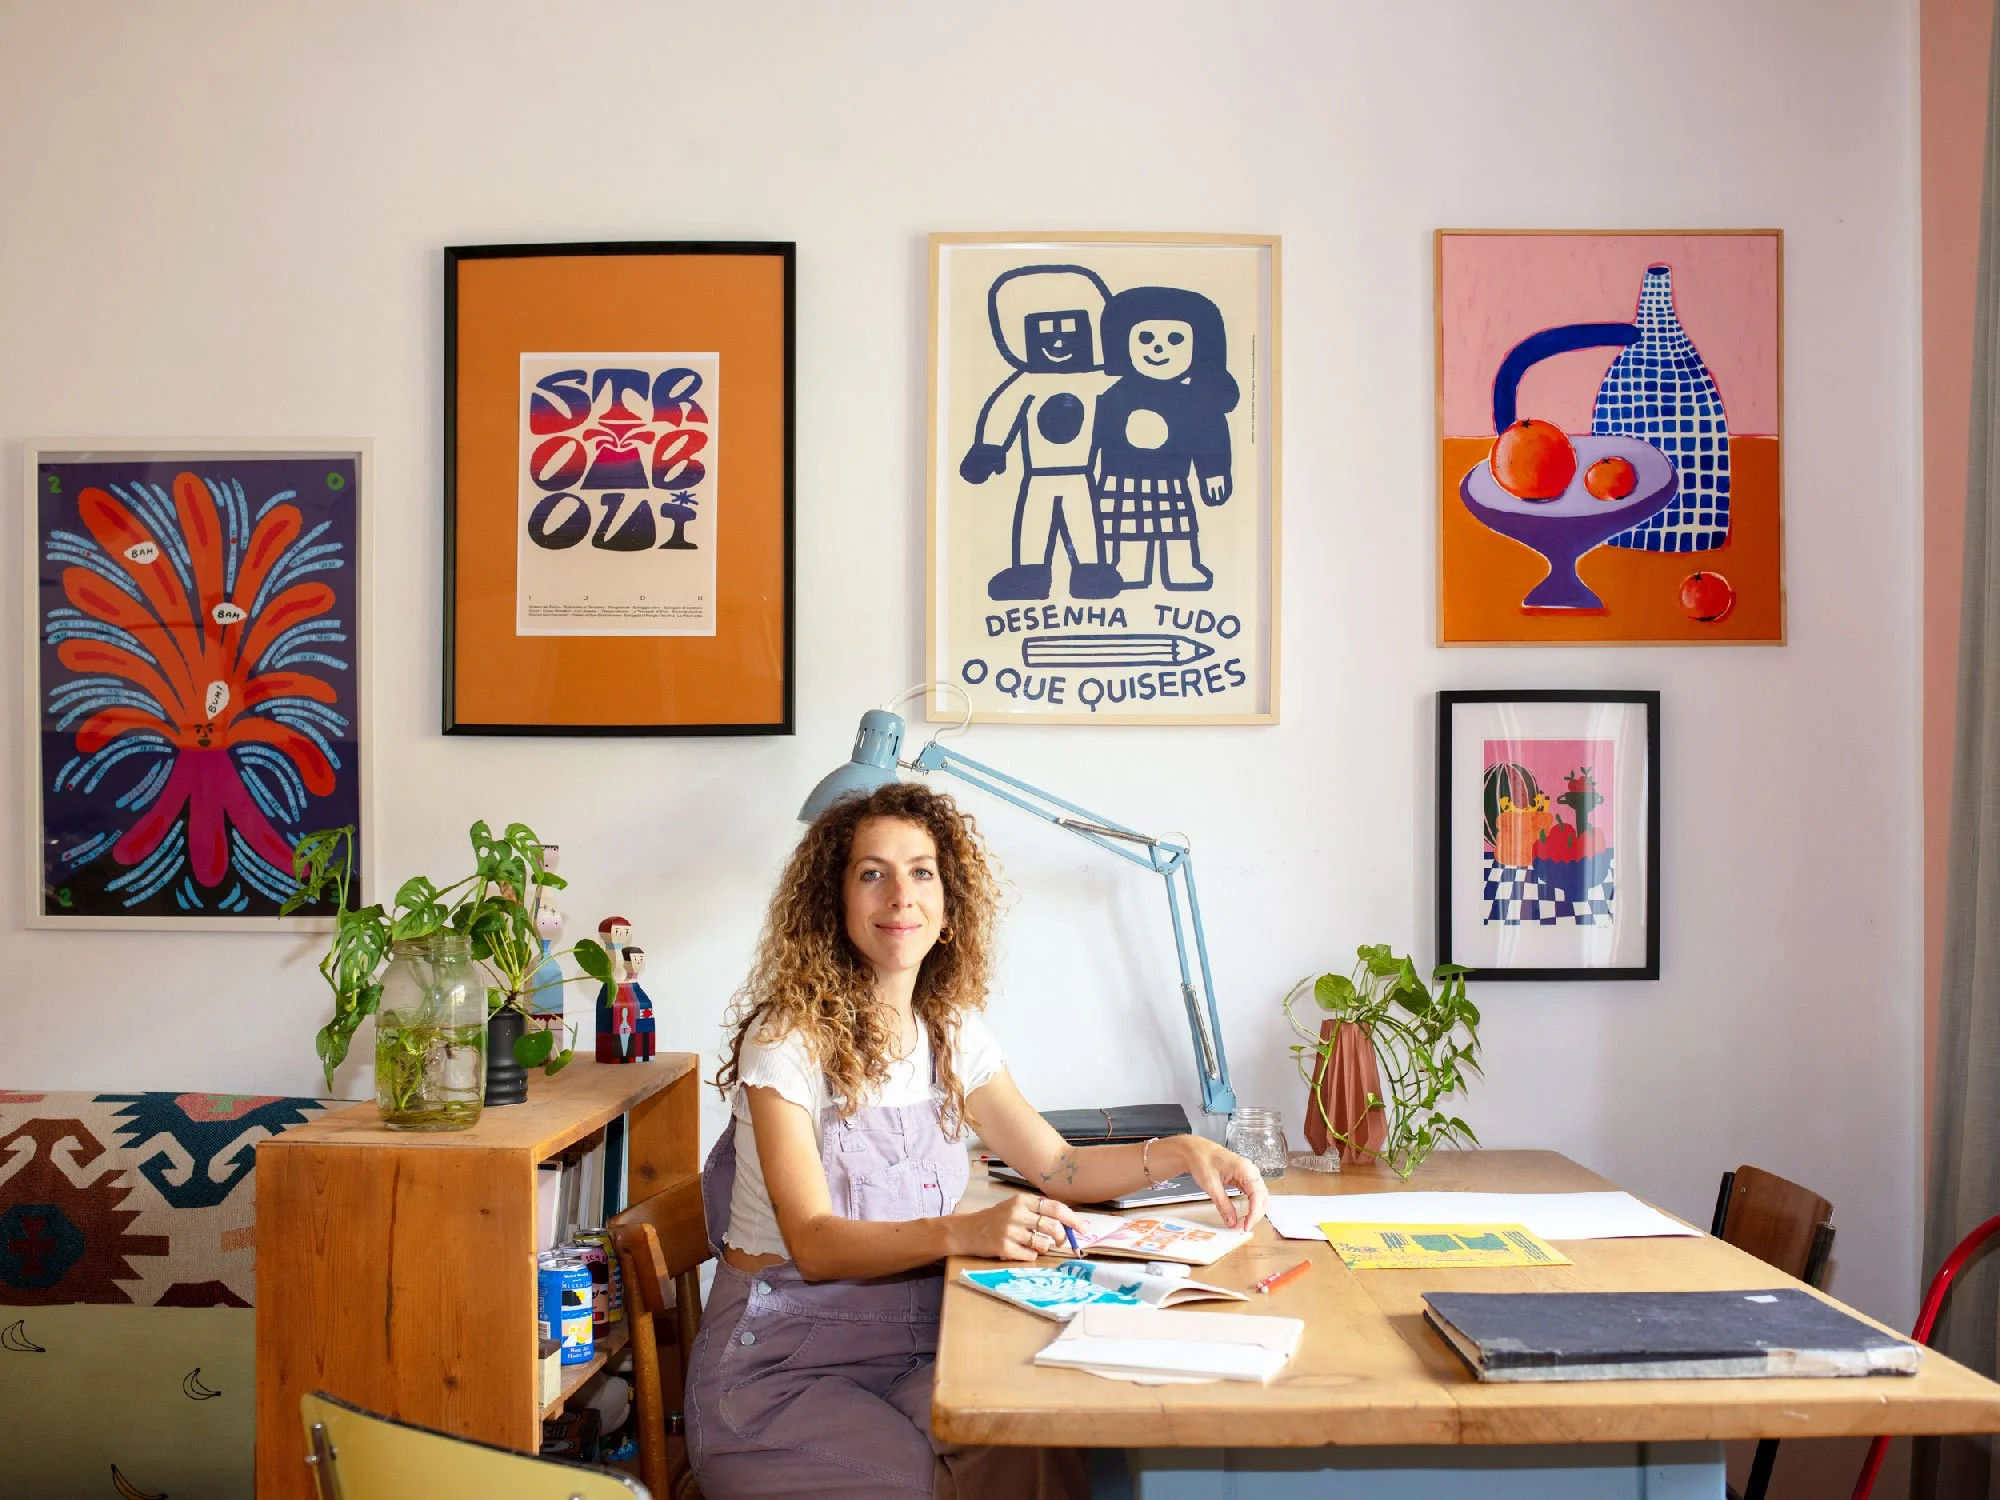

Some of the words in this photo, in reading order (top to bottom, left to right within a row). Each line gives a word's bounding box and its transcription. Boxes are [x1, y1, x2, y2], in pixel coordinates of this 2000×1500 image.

[47, 475, 63, 494] 2
[131, 548, 154, 559] BAM
[217, 609, 240, 620] BAM
[985, 604, 1128, 637] DESENHA
[1154, 604, 1241, 639] TUDO
[962, 658, 989, 685] O
[996, 667, 1066, 705] QUE
[1077, 658, 1247, 713] QUISERES
